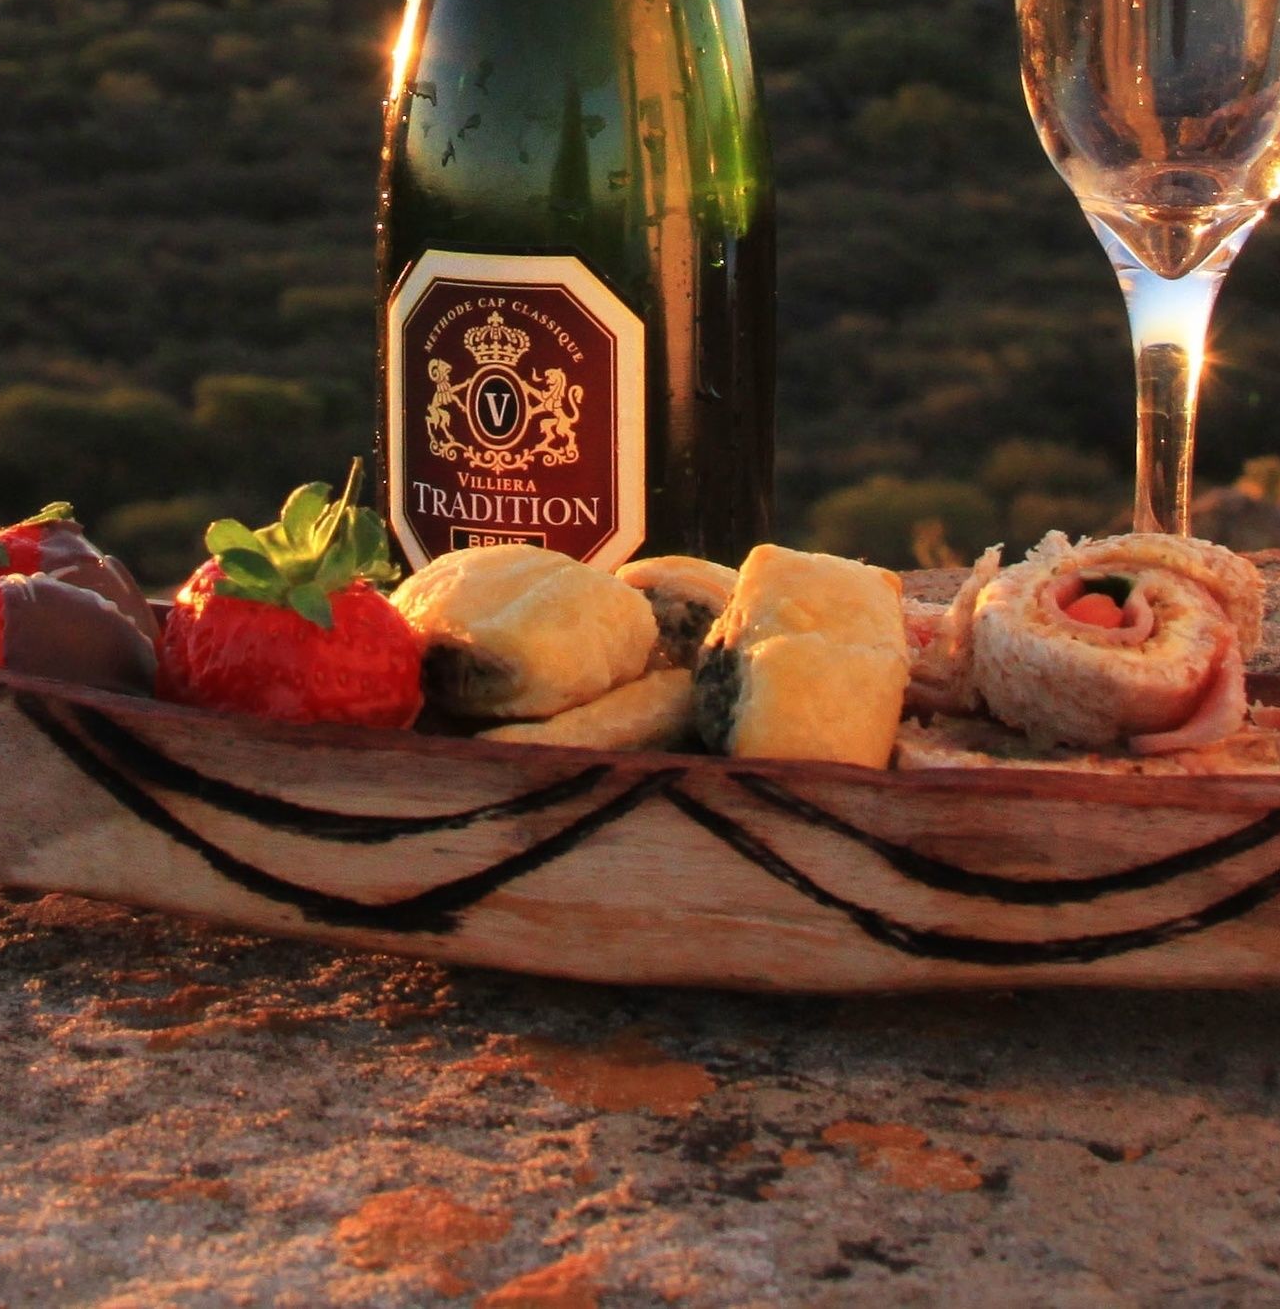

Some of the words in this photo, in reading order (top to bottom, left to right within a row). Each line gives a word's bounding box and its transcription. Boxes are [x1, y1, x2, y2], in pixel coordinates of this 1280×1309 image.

[424, 301, 474, 353] METHODE
[478, 297, 506, 308] CAP
[511, 300, 585, 363] CLASSIQUE
[484, 392, 511, 427] V
[456, 471, 537, 492] VILLIERA
[413, 481, 600, 526] TRADITION
